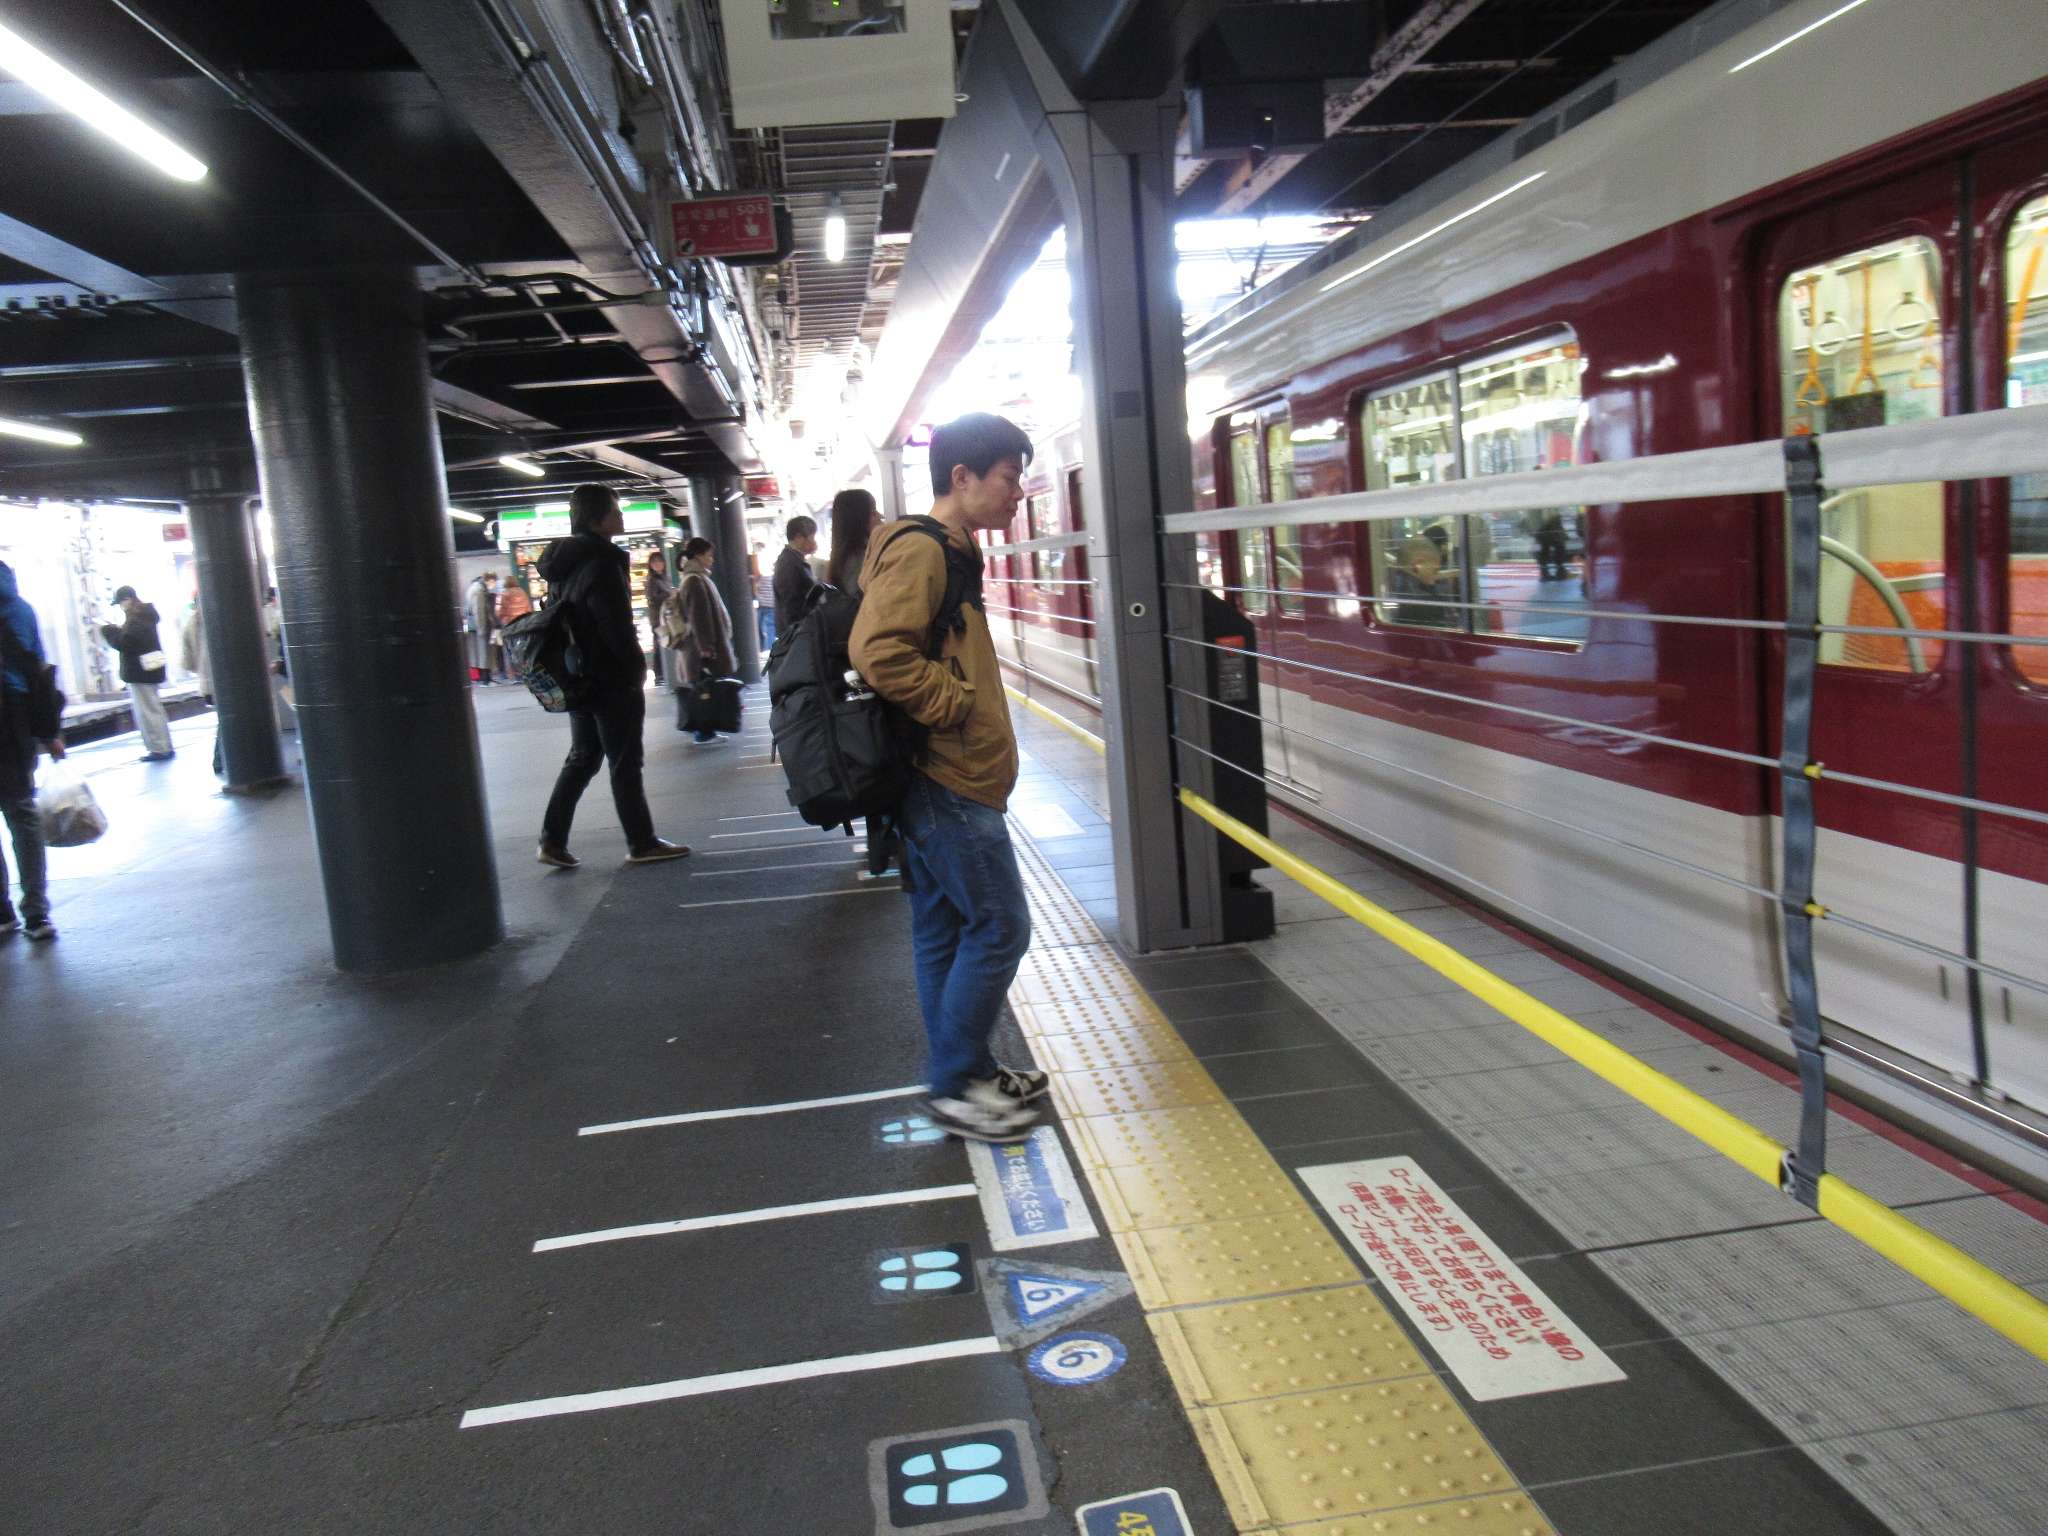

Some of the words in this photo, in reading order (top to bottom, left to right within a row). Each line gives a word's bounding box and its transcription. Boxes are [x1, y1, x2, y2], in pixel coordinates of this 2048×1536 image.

[736, 203, 767, 215] SOS
[1375, 1184, 1537, 1345] 内側に下がってお待ちください
